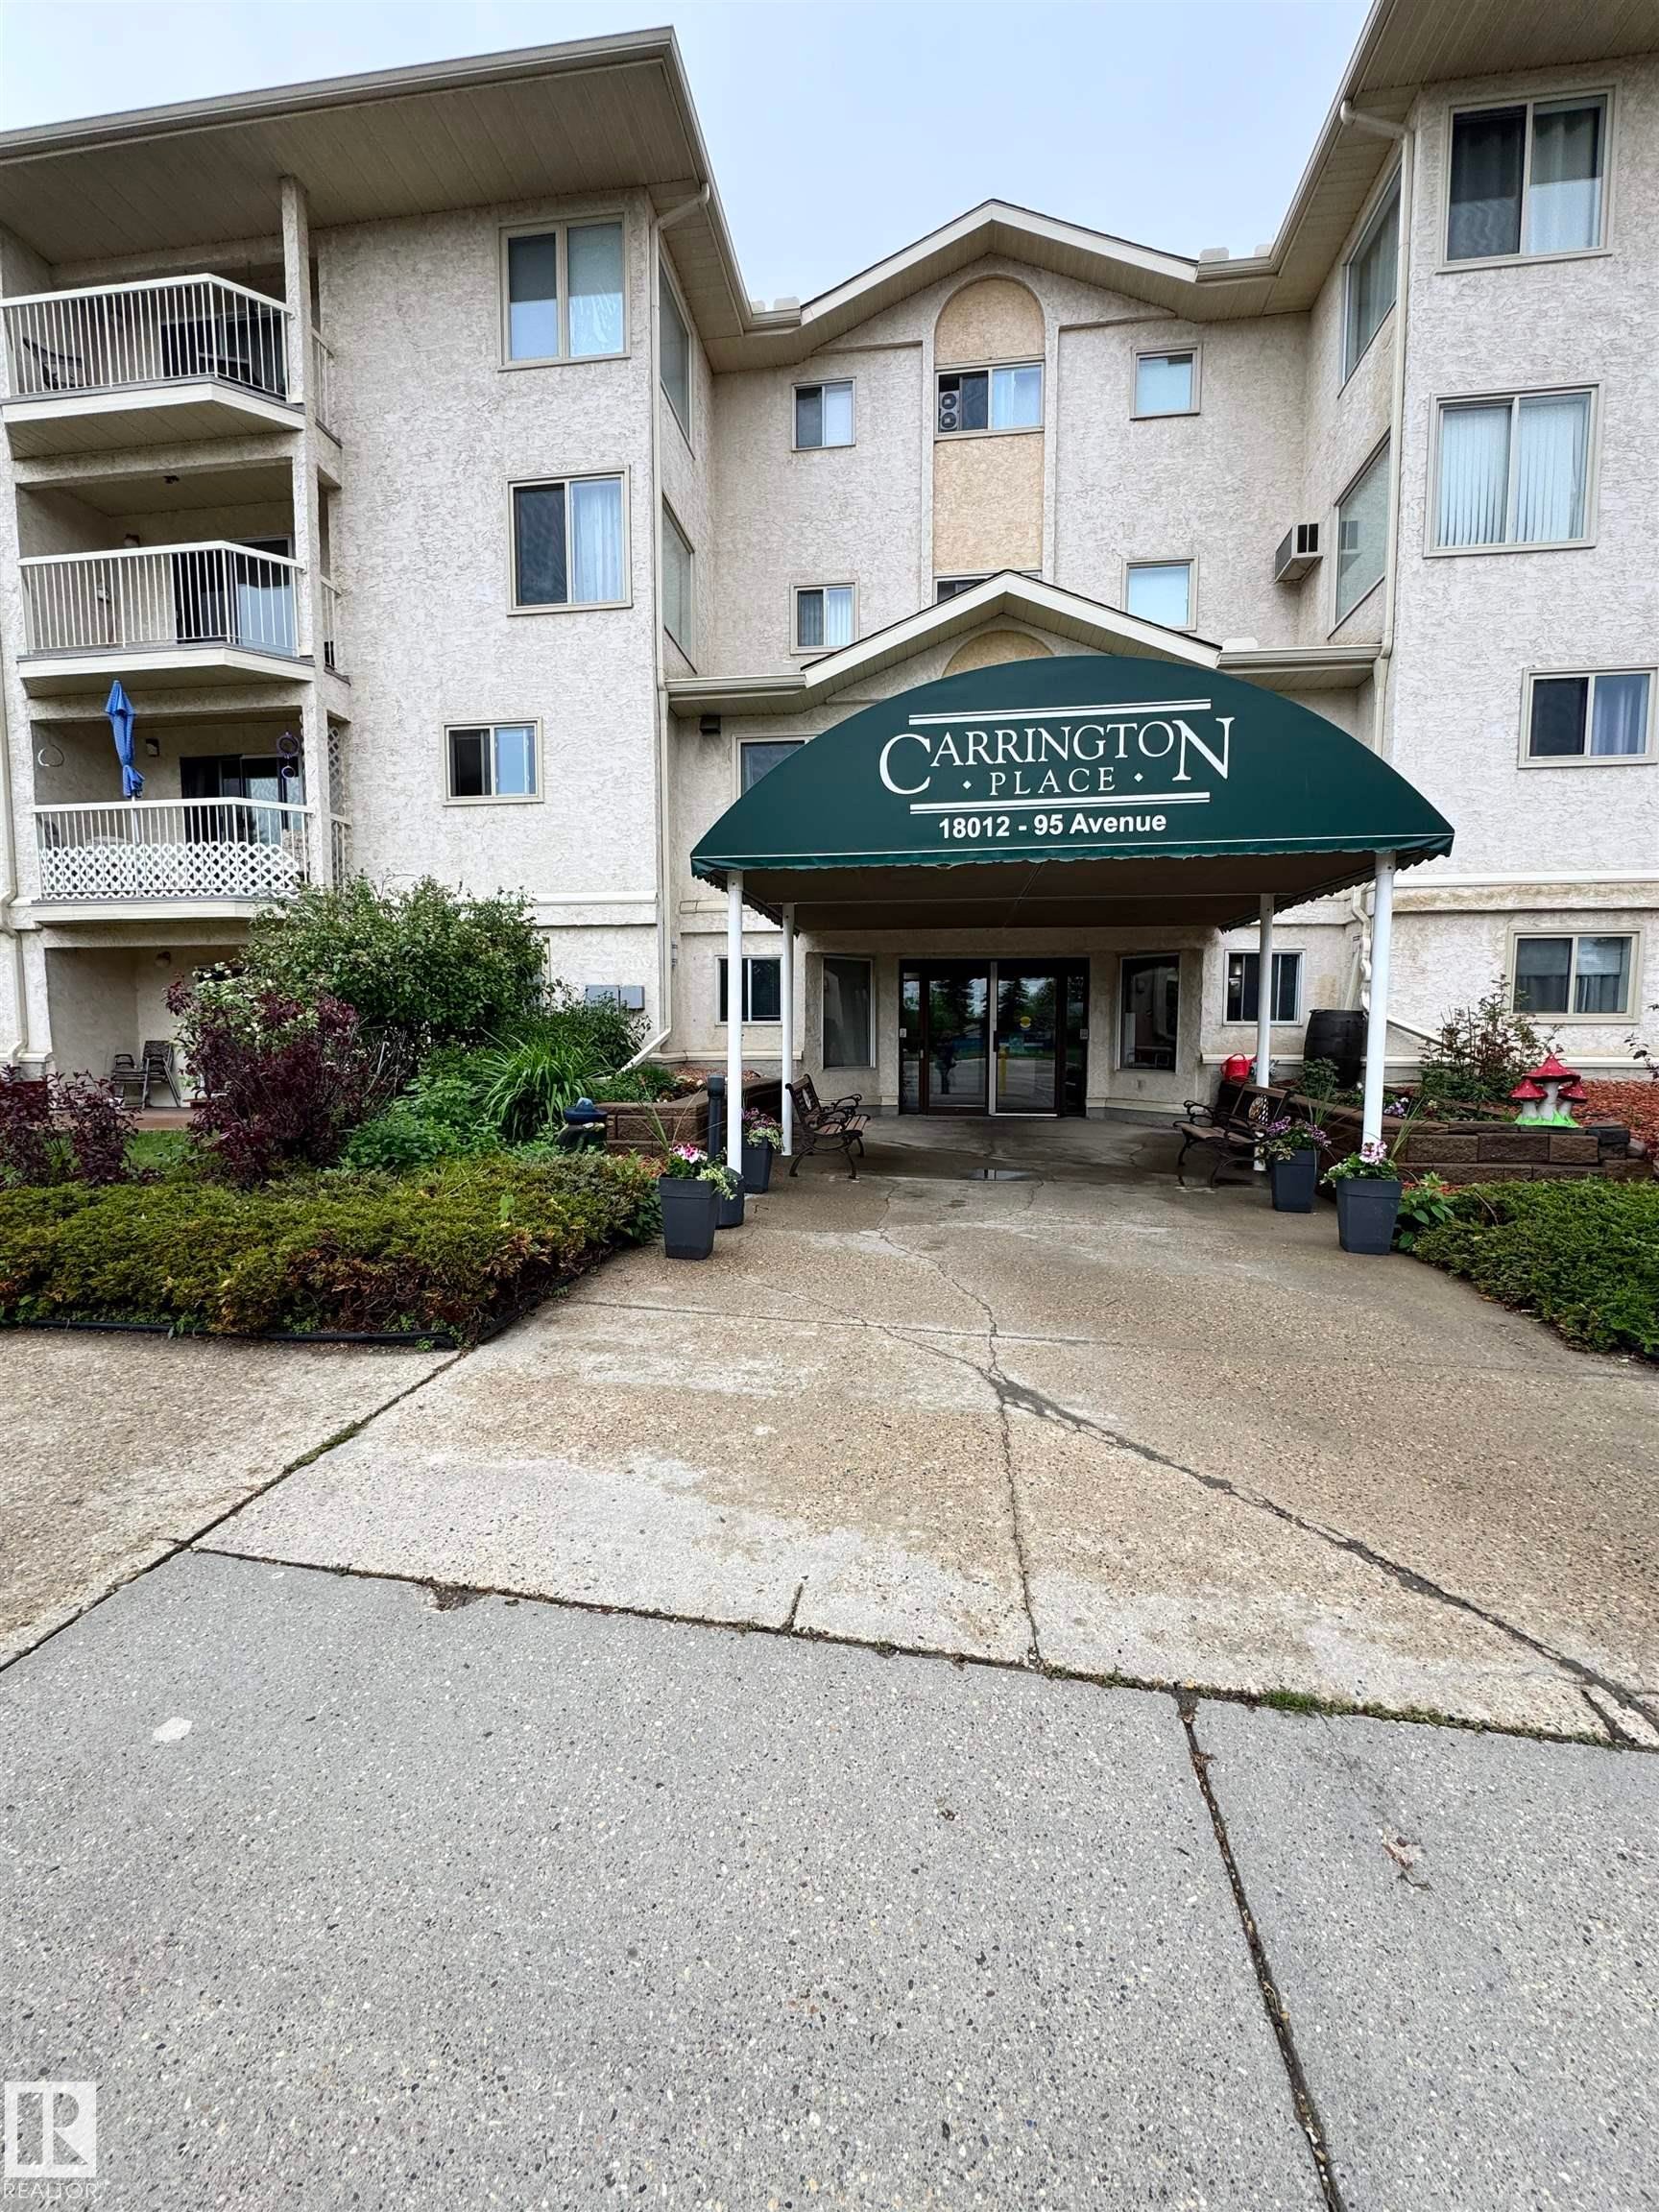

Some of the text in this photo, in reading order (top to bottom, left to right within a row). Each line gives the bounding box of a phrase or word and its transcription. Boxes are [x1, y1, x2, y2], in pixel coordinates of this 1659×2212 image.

[878, 716, 1236, 795] CARRINGTON
[990, 767, 1116, 796] PLACE
[938, 816, 1010, 839] 18012
[1033, 814, 1064, 836] 95
[1070, 813, 1167, 834] Avenue
